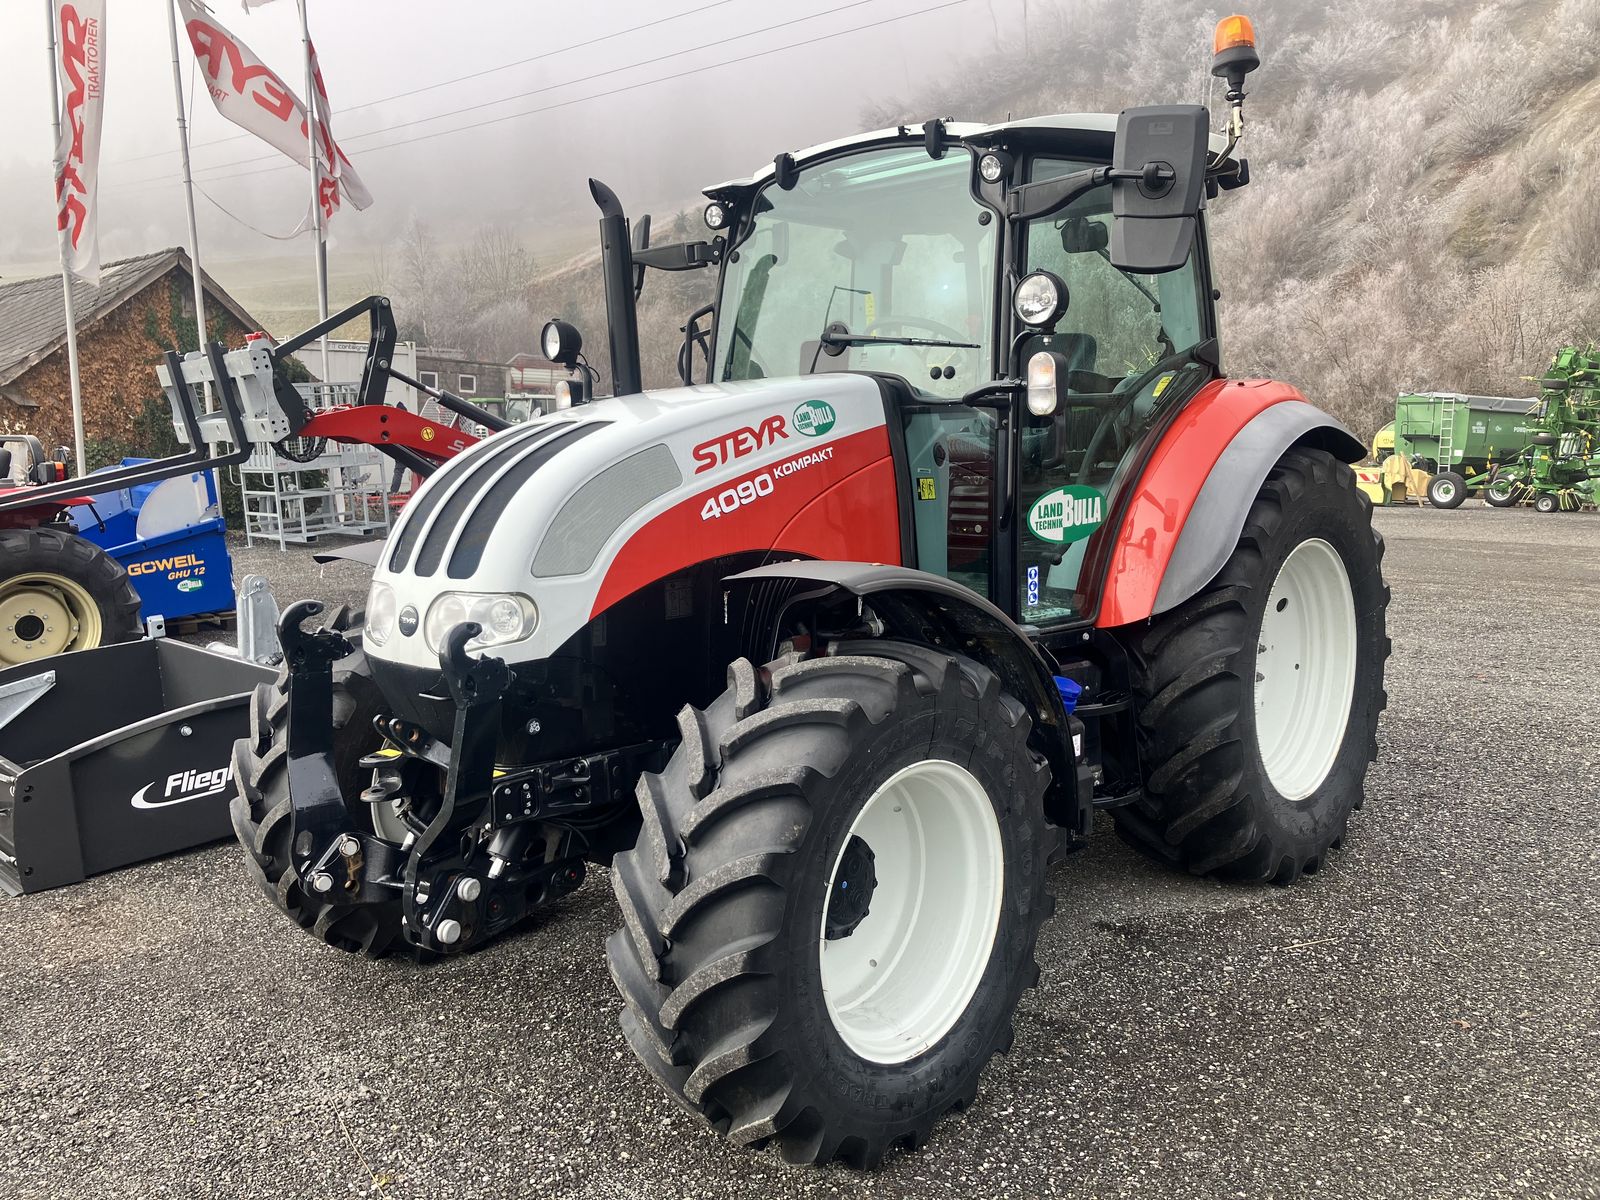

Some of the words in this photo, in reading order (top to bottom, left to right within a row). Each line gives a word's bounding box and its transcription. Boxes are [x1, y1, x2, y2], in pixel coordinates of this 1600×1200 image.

[87, 17, 100, 100] TRAKTOREN
[810, 405, 834, 427] BULLA
[692, 415, 790, 475] STEYR
[700, 473, 774, 521] 4090
[773, 447, 834, 479] KOMPAKT
[1035, 517, 1063, 531] TECHNIK
[1038, 502, 1063, 519] LAND
[1062, 494, 1102, 528] BULLA
[167, 569, 191, 580] GHU
[193, 566, 206, 576] 12
